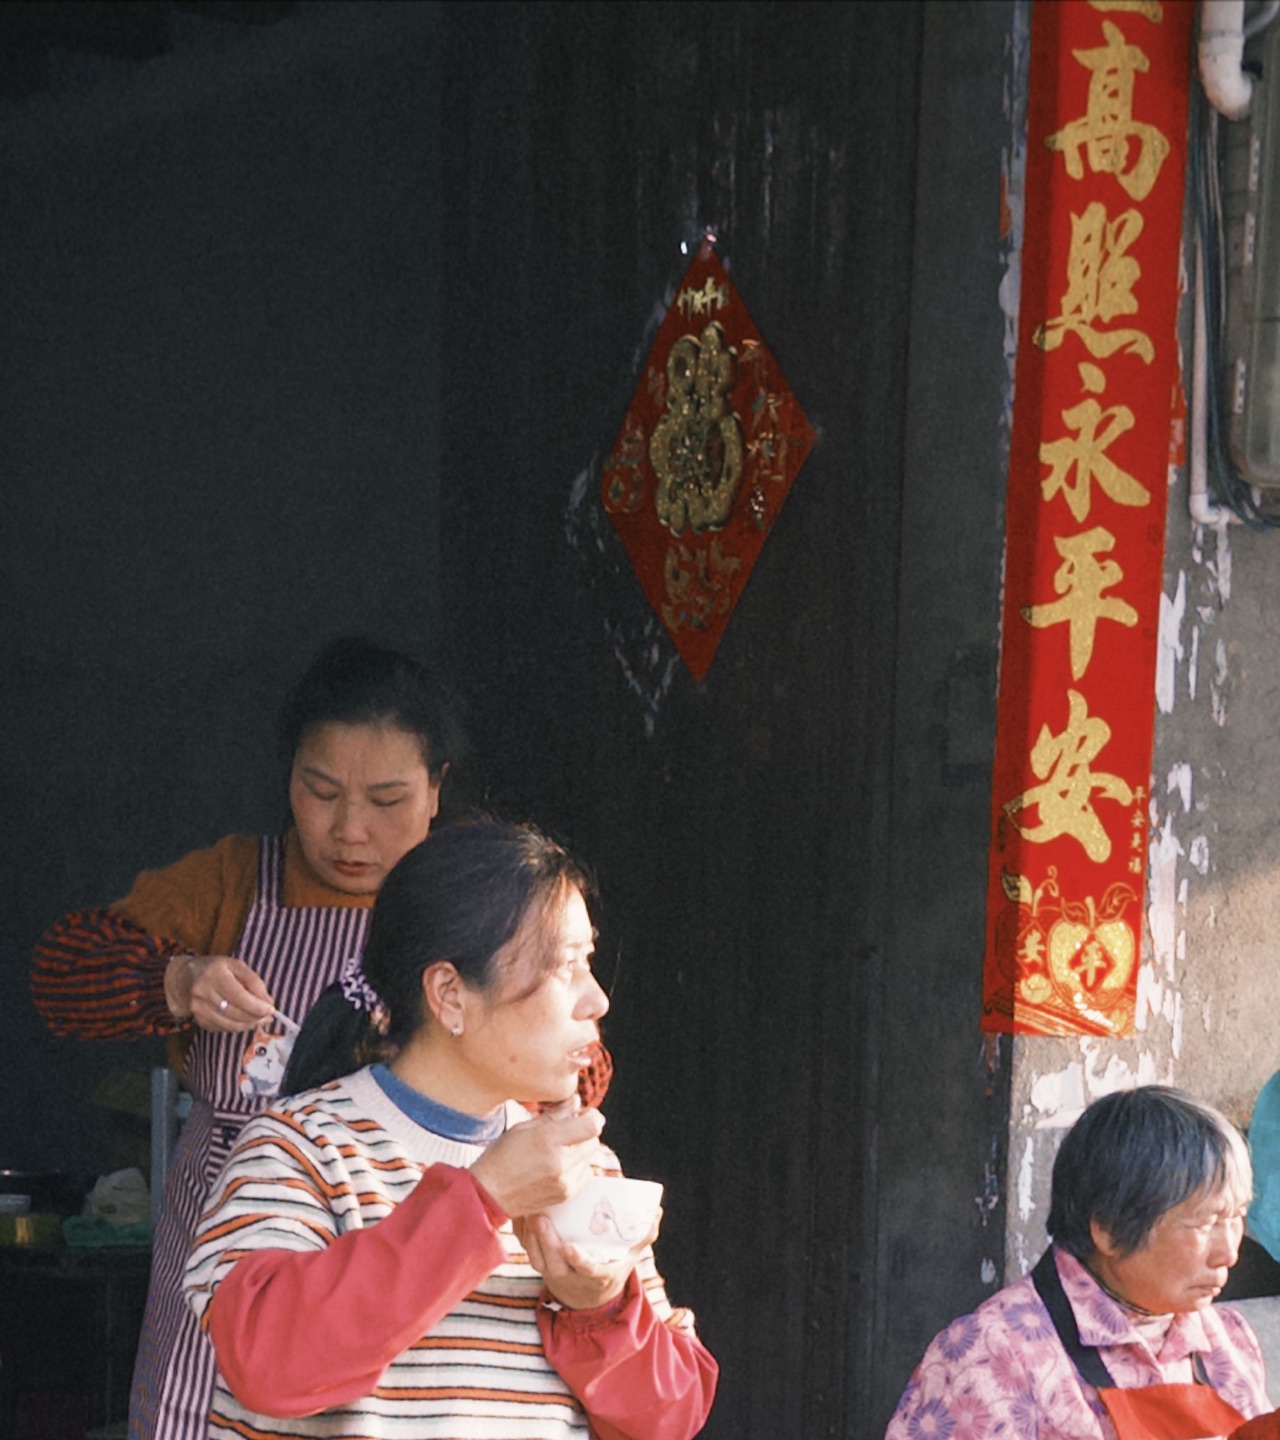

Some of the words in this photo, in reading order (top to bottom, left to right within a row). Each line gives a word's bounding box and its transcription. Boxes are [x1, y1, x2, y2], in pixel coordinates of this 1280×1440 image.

[1003, 0, 1170, 863] 高照永平安
